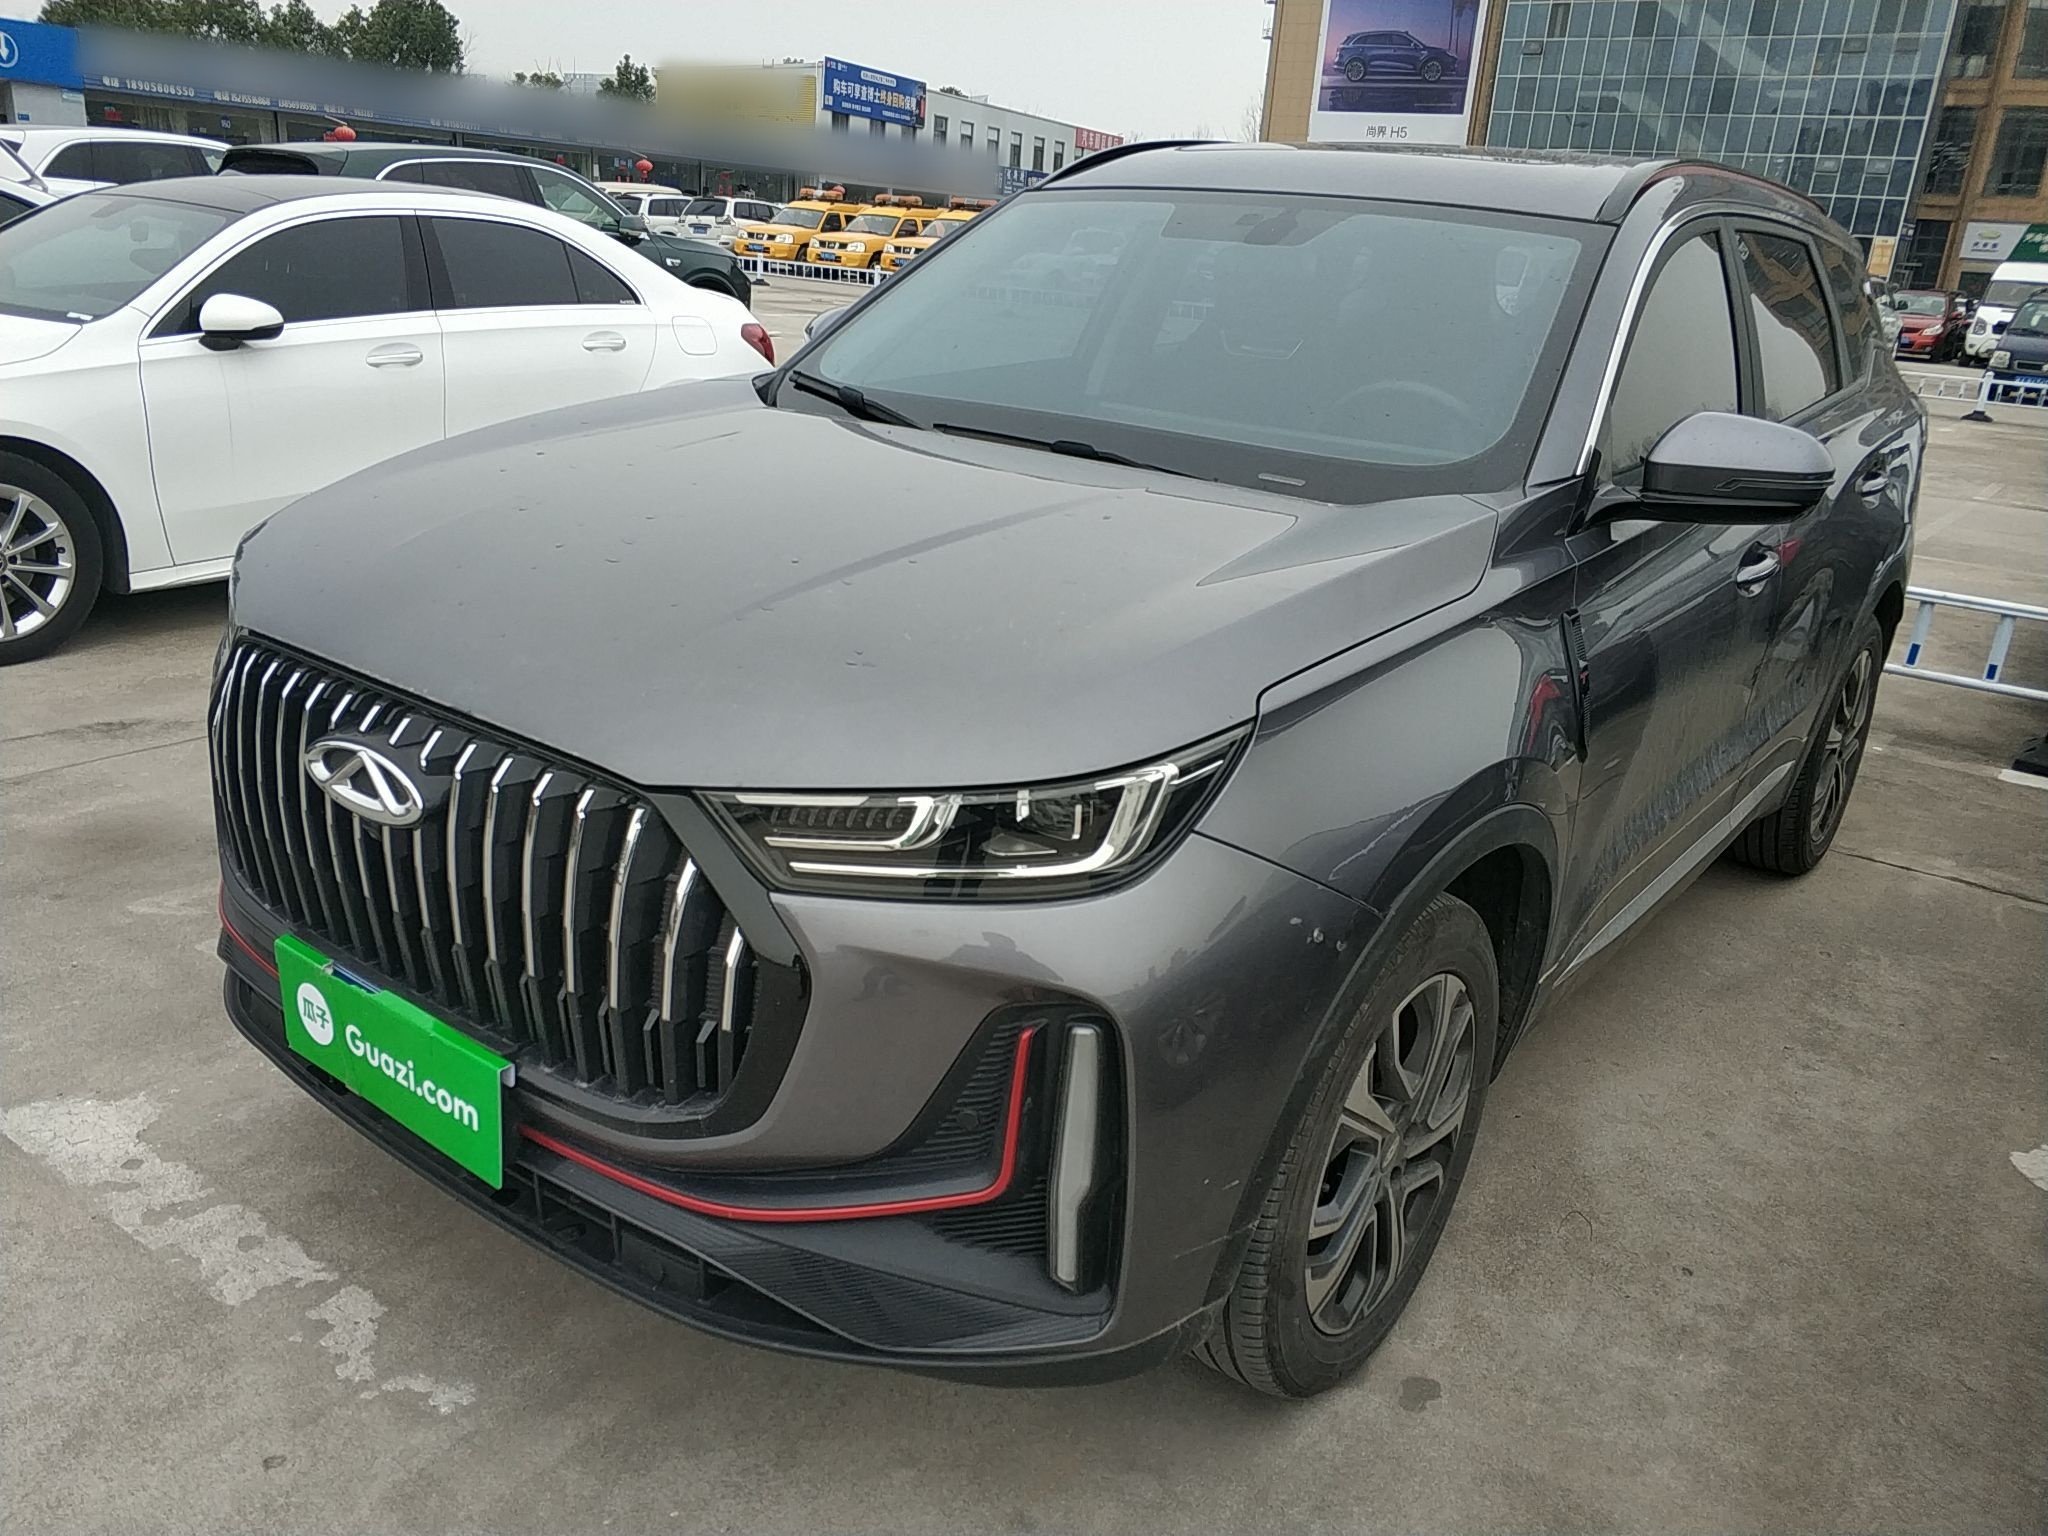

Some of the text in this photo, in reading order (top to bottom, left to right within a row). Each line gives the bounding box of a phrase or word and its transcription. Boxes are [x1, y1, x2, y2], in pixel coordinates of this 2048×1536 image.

[1366, 125, 1408, 139] 尚界 H5
[302, 996, 329, 1029] 瓜子
[345, 1024, 479, 1132] Guazi.com
